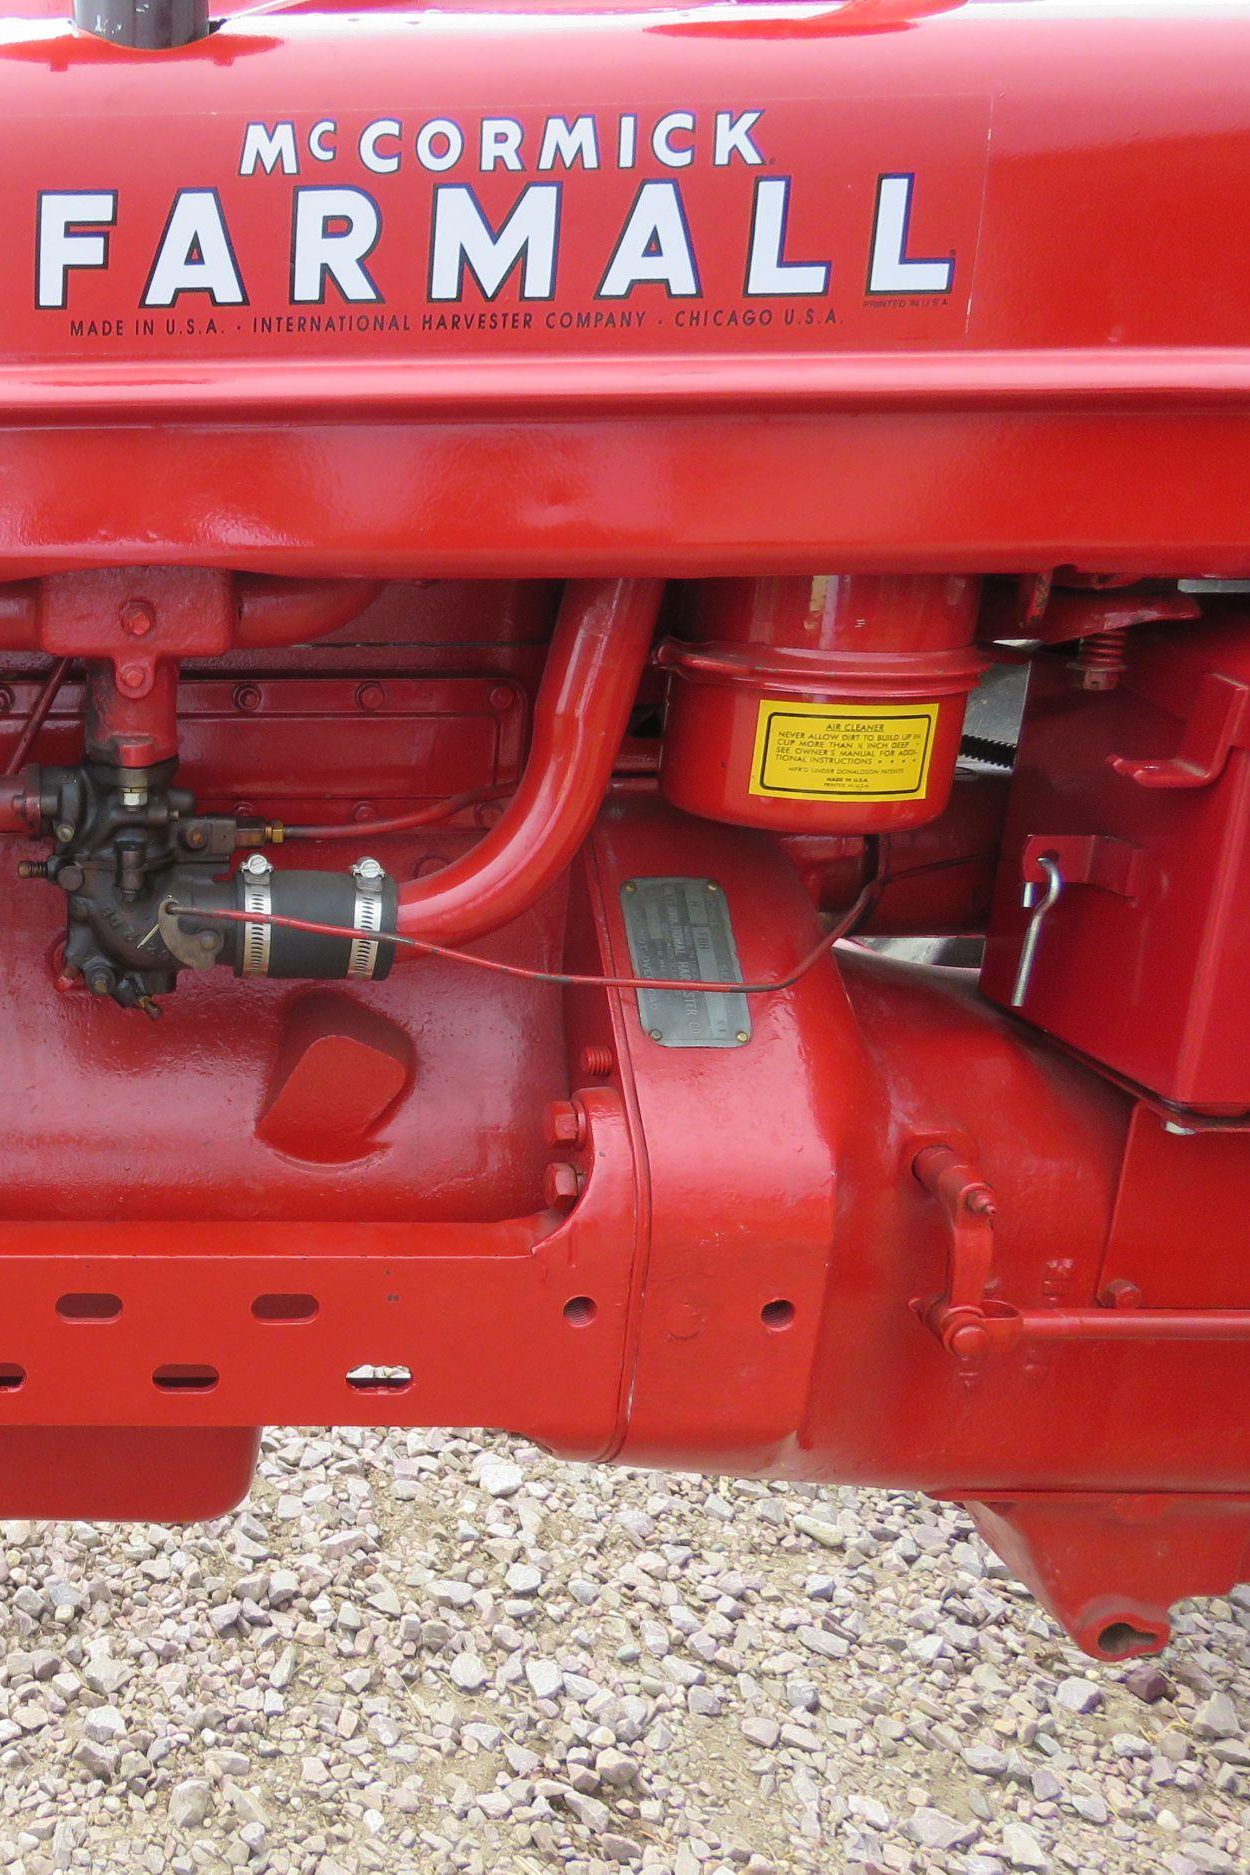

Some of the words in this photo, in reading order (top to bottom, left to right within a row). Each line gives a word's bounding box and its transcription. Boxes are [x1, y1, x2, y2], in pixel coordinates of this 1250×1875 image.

[34, 172, 955, 310] FARMALL
[70, 319, 124, 336] MADE
[135, 319, 154, 335] IN
[166, 318, 224, 335] U.S.A.
[253, 314, 410, 333] INTERNATIONAL
[422, 311, 533, 331] HARVESTER
[546, 311, 646, 329] COMPANY
[675, 309, 773, 327] CHICAGO
[784, 308, 844, 325] U.S.A.
[826, 723, 841, 731] AIR
[845, 723, 884, 732] CLEANER
[778, 731, 805, 739] NEVER
[808, 733, 838, 741] ALLOW
[777, 738, 795, 746] CUP
[799, 740, 824, 748] MORE
[776, 746, 790, 754] SEE
[795, 747, 835, 756] OWNER'S
[775, 754, 806, 762] TIONAL
[810, 757, 872, 765] INSTRUCTIONS
